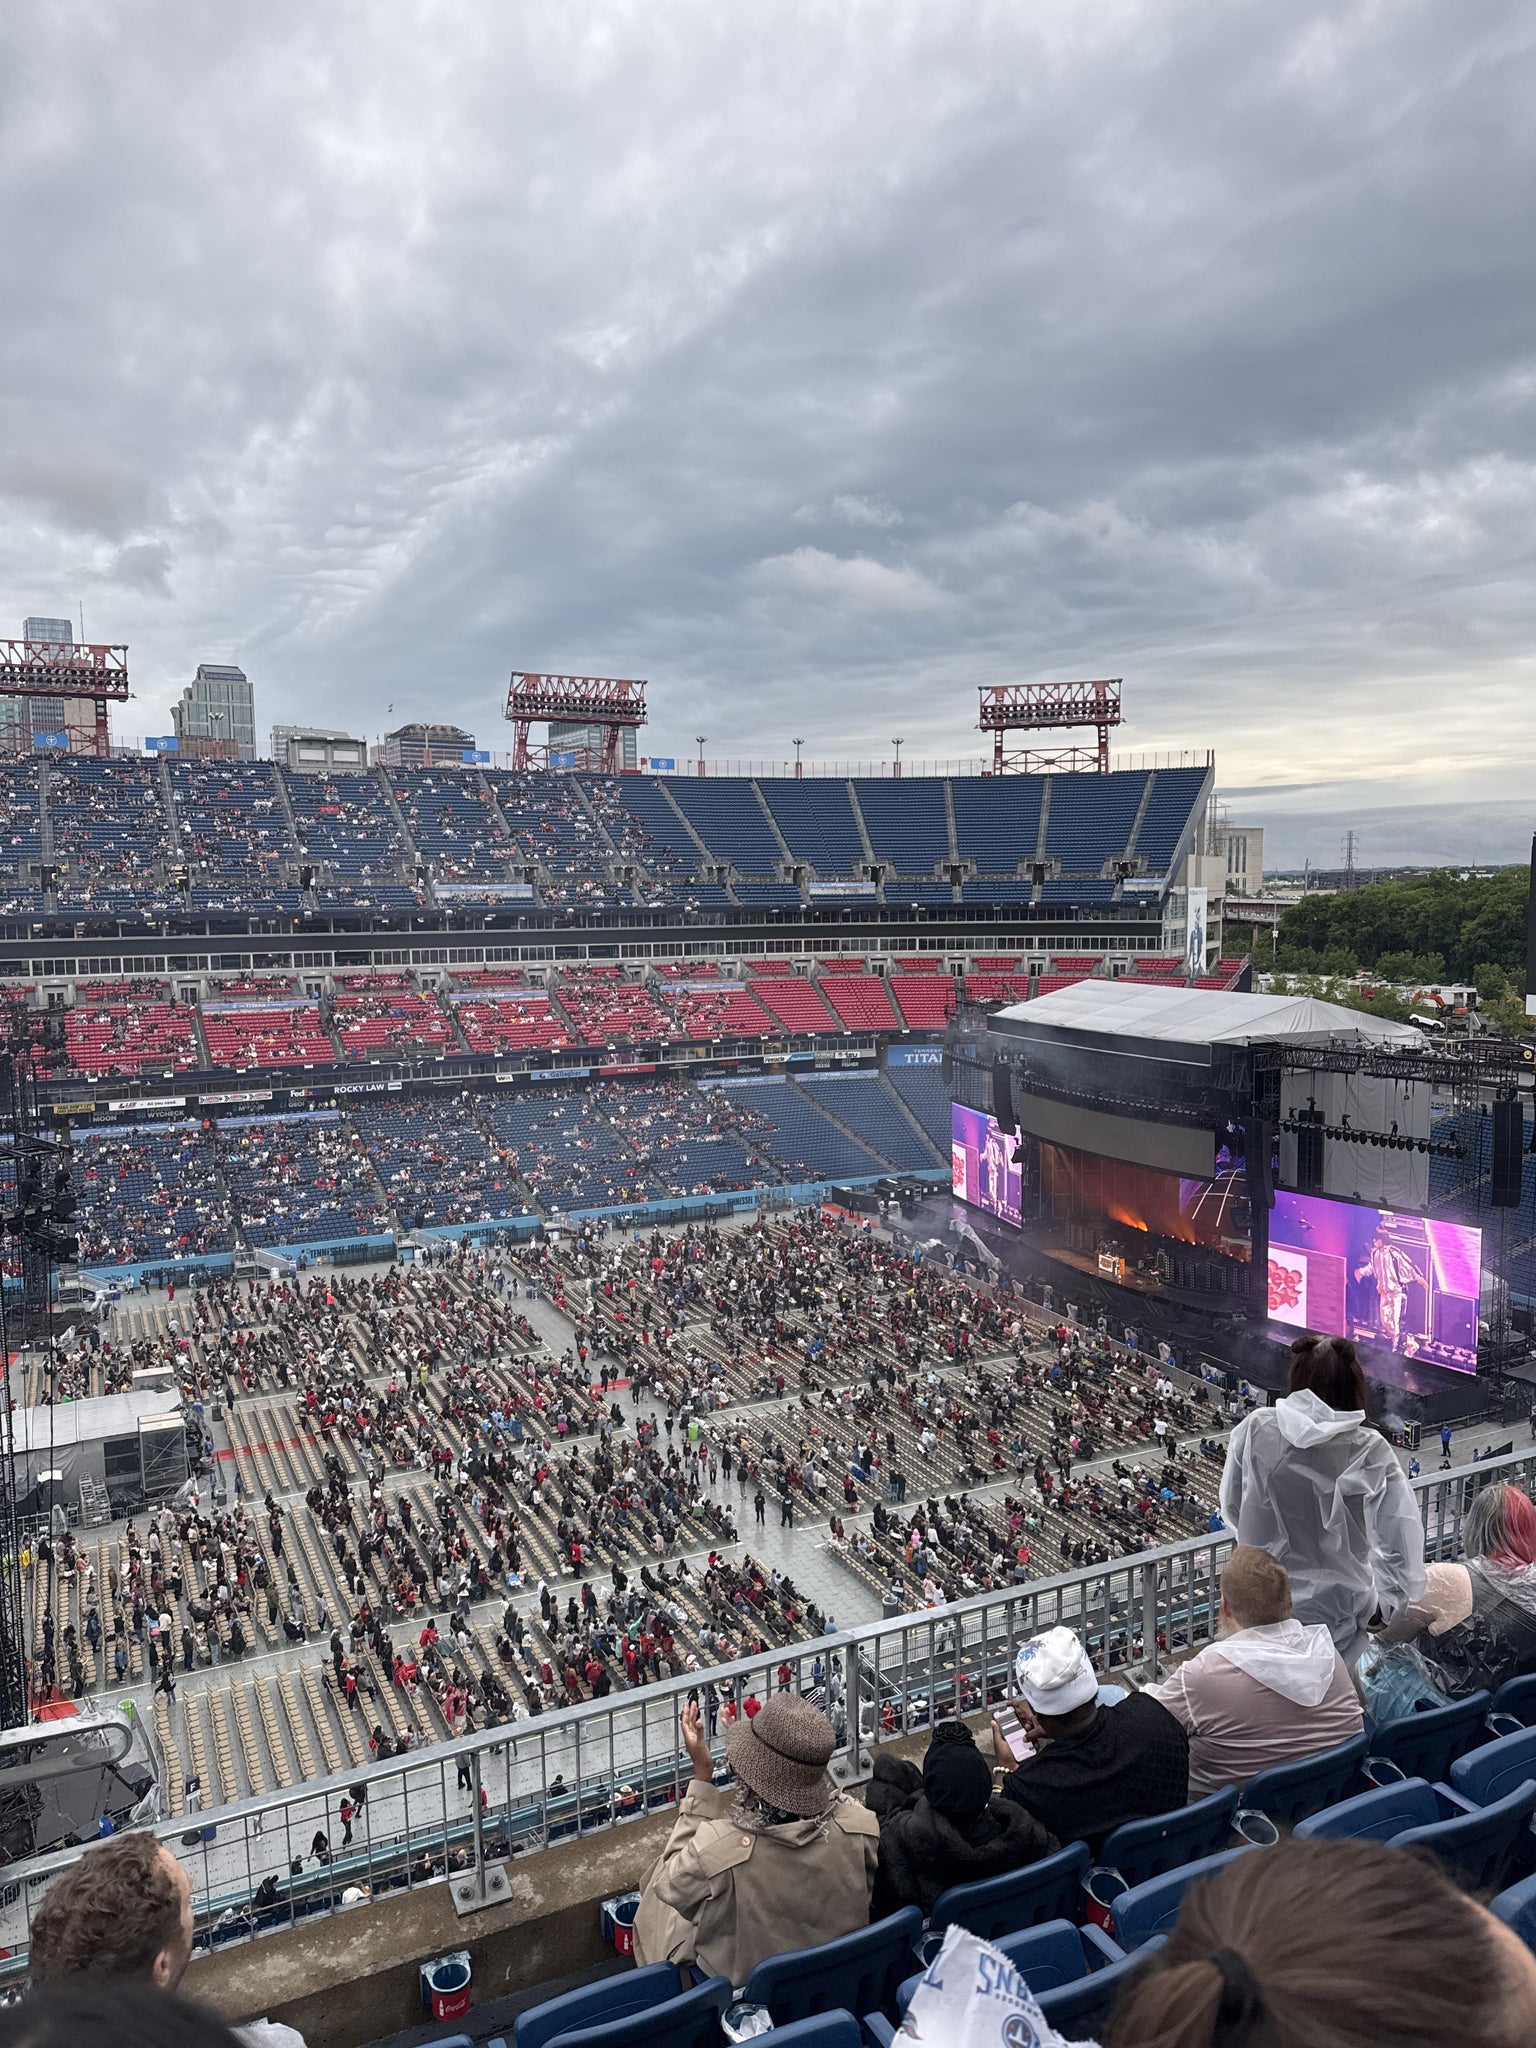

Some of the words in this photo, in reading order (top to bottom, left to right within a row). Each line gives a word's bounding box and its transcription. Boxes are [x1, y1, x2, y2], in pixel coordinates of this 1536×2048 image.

[551, 1069, 581, 1078] Gallagher
[290, 1088, 314, 1097] FedEx
[334, 1085, 364, 1094] ROCKY
[366, 1083, 385, 1092] LAW
[147, 1110, 185, 1118] WYCHECK
[310, 1245, 346, 1259] TENNESSEE
[190, 1782, 196, 1792] F
